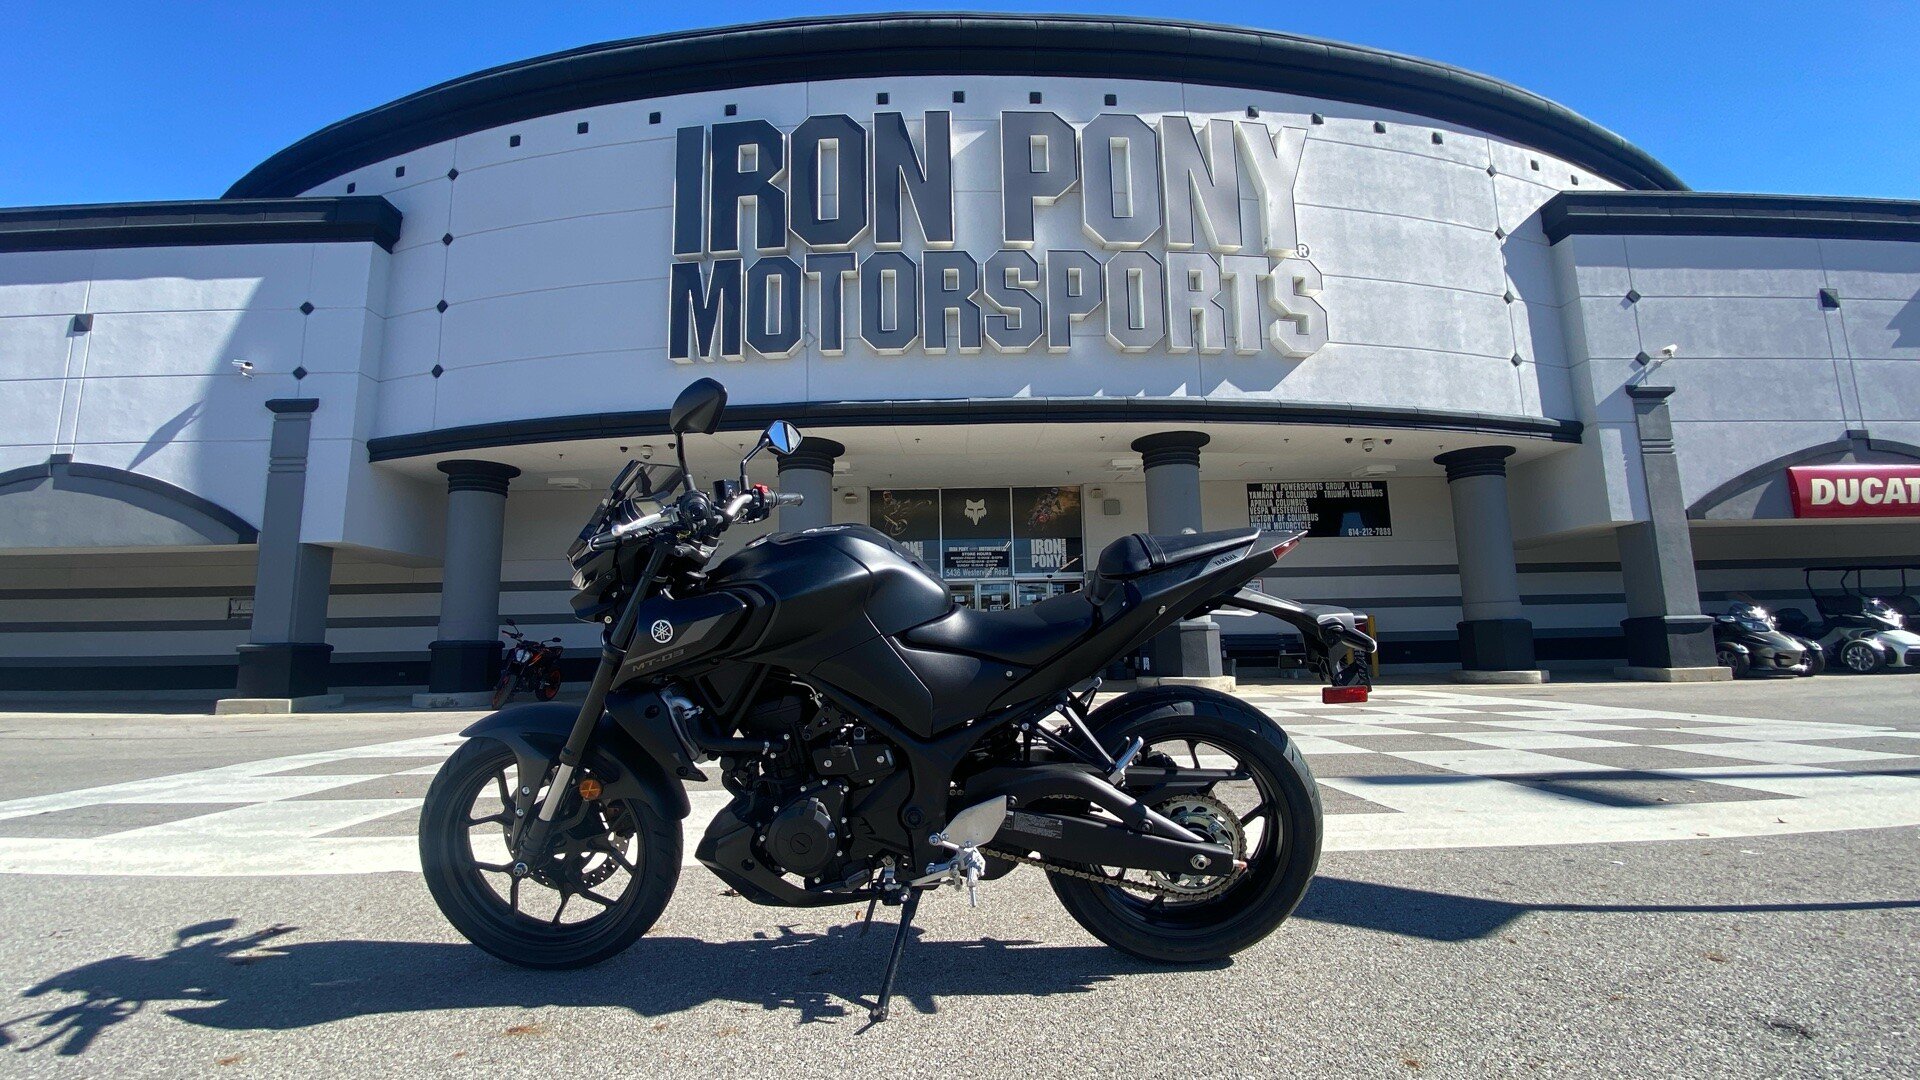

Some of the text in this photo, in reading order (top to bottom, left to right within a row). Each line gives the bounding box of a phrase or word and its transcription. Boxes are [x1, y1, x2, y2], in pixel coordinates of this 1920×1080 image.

[673, 110, 1309, 257] IRON PONY
[668, 250, 1329, 363] MOTORSPORTS
[1261, 483, 1278, 492] PONY
[1280, 482, 1324, 491] POWERSPORTS
[1325, 482, 1348, 490] GROUP,
[1349, 481, 1360, 490] LLC
[1249, 489, 1383, 500] YAMAHA OF COLUMBUS TRIUMPH COLUMBUS
[1250, 498, 1308, 507] APRILIA COLUMBUS
[1250, 505, 1309, 515] VESPA WESTERVILLE
[1250, 513, 1319, 523] VICTORY OF COLUMBUS
[1250, 521, 1312, 530] INDIAN MOTORCYCLE
[1031, 538, 1061, 555] IRON
[1031, 554, 1061, 568] PONY
[1213, 554, 1239, 566] YAMAHA
[963, 568, 992, 576] Westerve
[994, 567, 1009, 576] Road
[632, 649, 684, 672] MT-03
